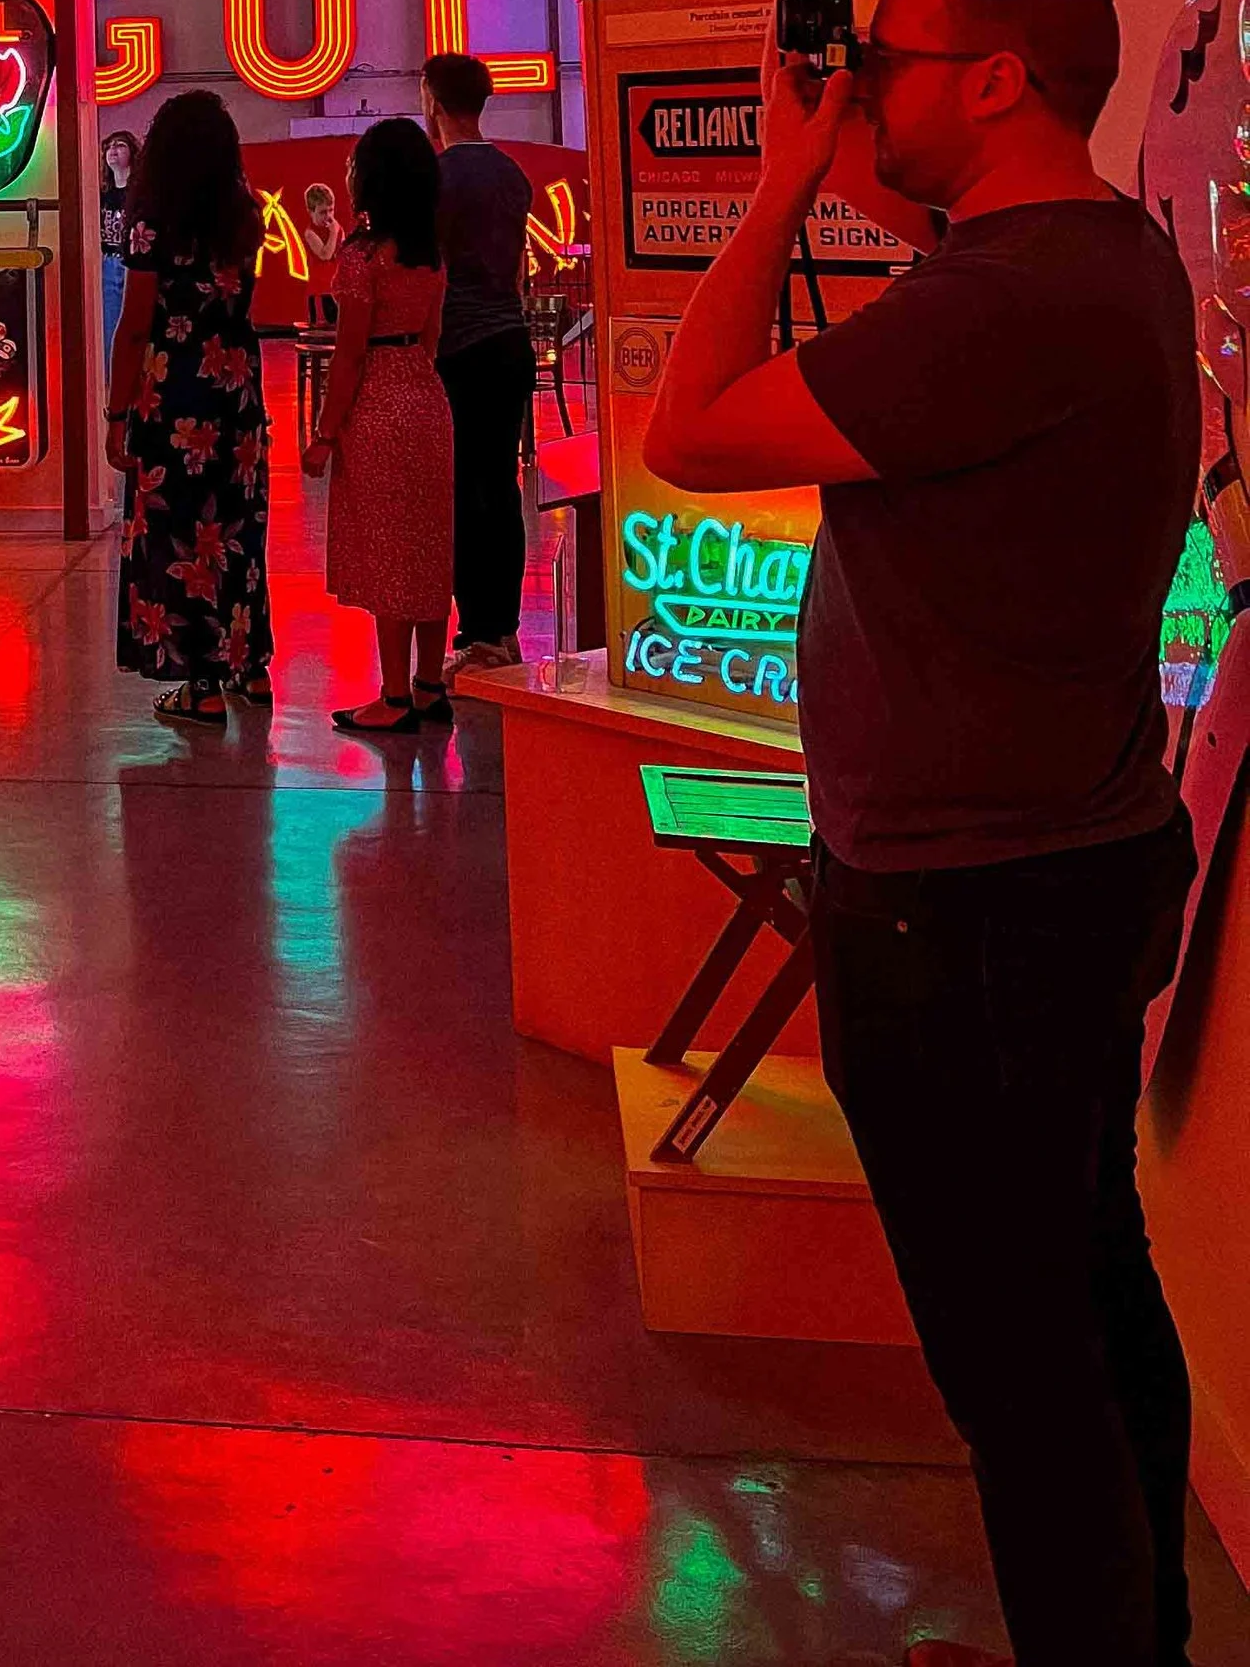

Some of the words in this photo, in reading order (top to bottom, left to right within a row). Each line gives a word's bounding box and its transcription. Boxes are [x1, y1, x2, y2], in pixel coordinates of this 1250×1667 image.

[642, 199, 748, 221] PORCELAI
[820, 226, 900, 247] SIGNS
[622, 347, 655, 367] BEER
[622, 510, 685, 591] St.
[689, 517, 812, 601] Char
[685, 605, 787, 631] DAIRY
[625, 630, 704, 685] ICE
